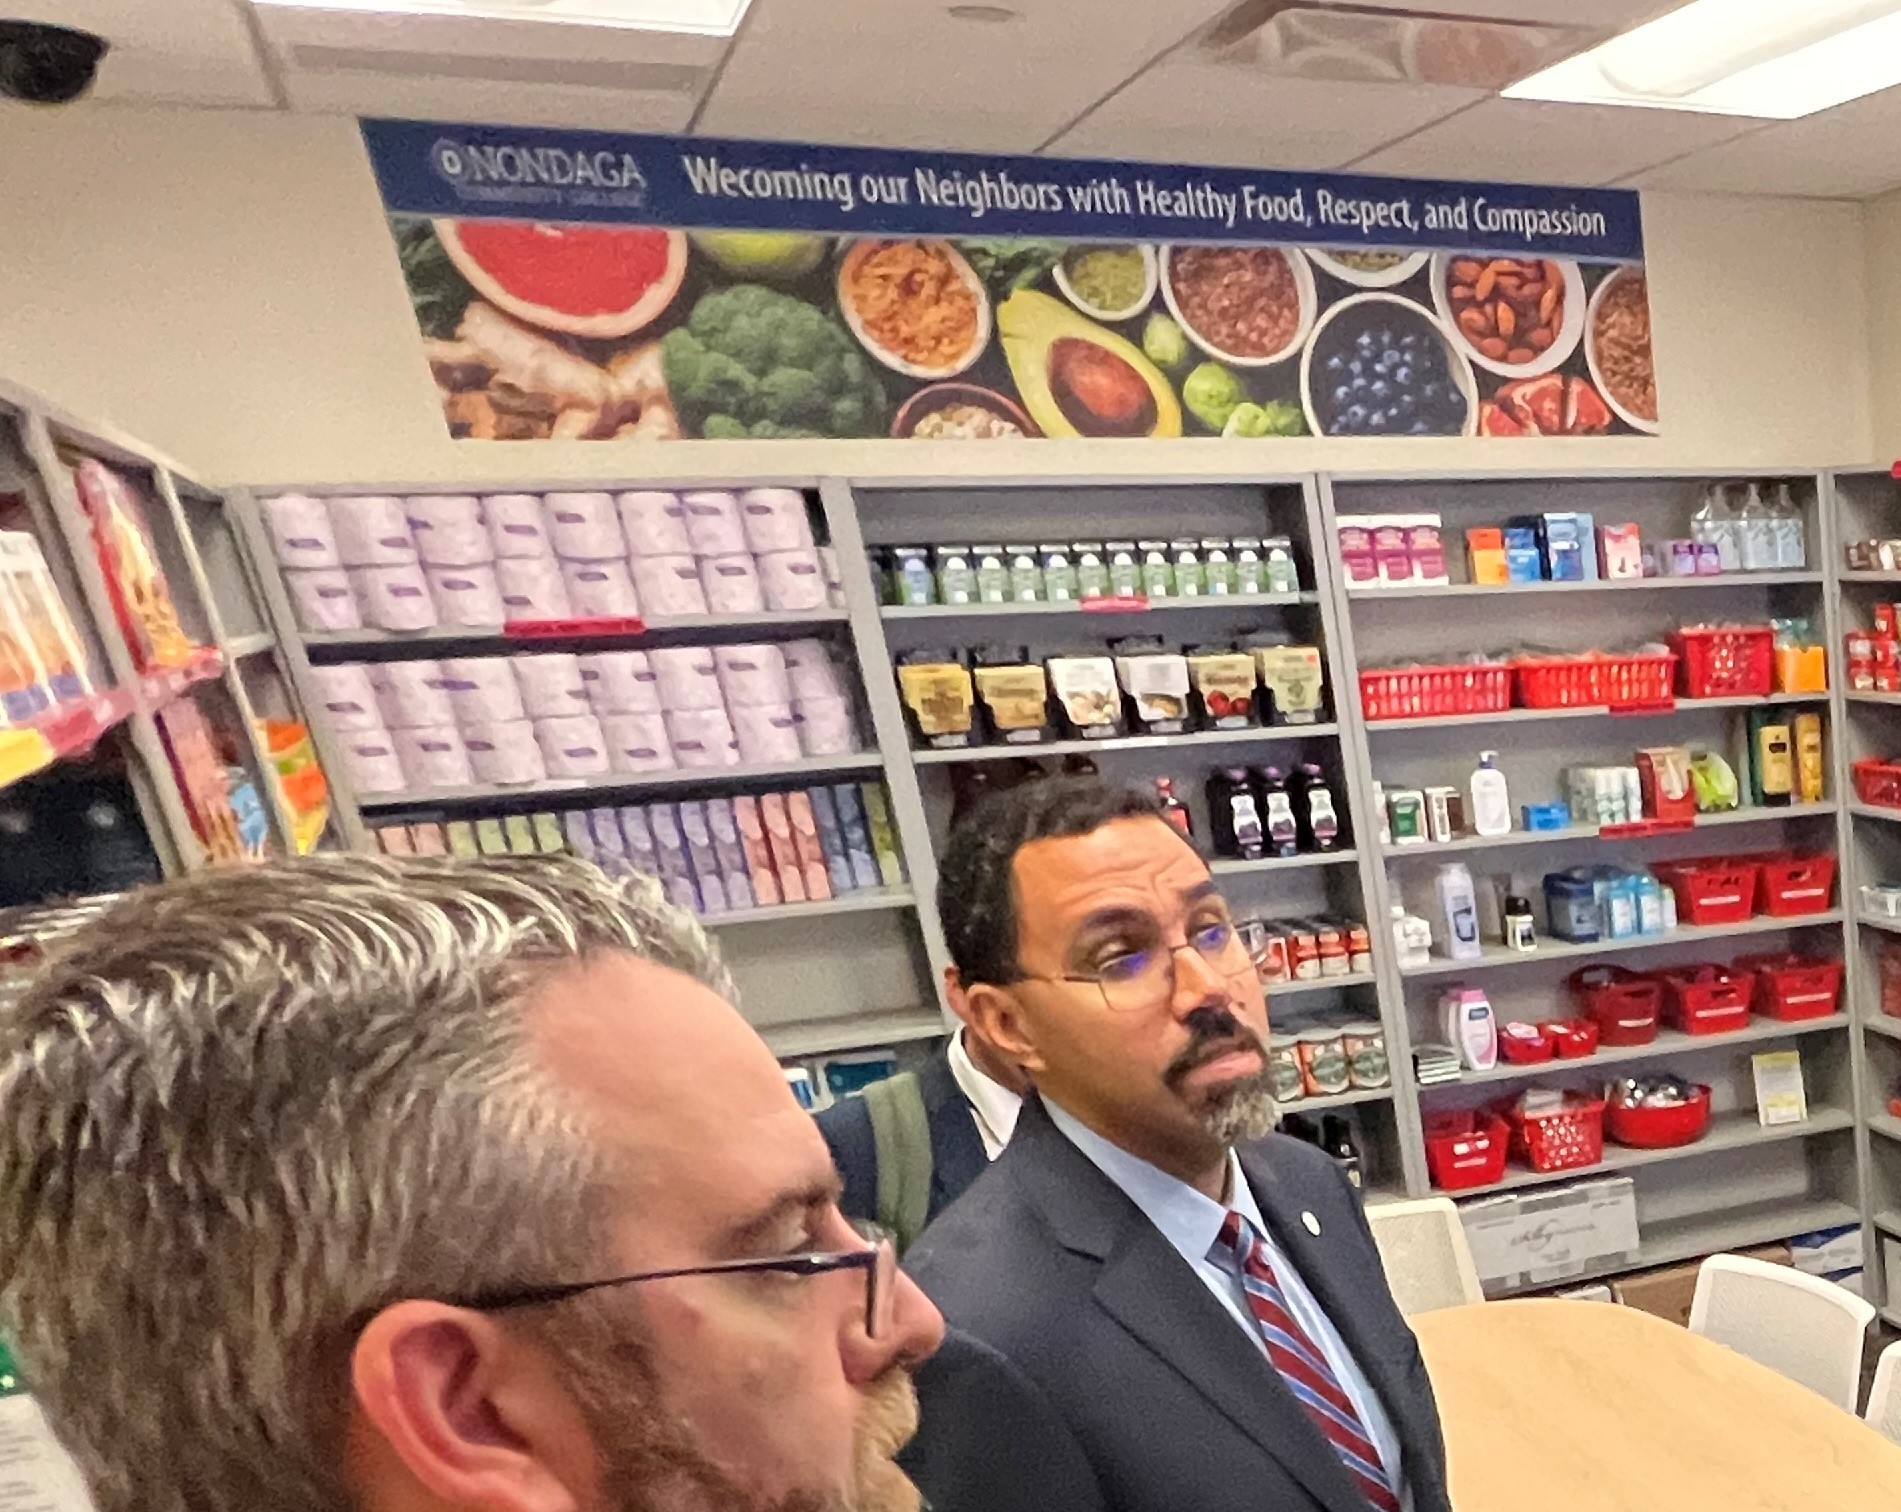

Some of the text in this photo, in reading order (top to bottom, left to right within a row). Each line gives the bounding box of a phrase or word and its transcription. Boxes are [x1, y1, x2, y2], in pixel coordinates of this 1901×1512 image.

[683, 155, 853, 212] Wecoming
[861, 171, 908, 204] our
[915, 166, 1063, 218] Neighbors
[1067, 178, 1130, 216] with
[1137, 178, 1238, 227] Healthy
[1243, 184, 1312, 227] Food,
[1318, 188, 1419, 235] Respect,
[1424, 197, 1468, 230] and
[1473, 196, 1606, 240] Compassion
